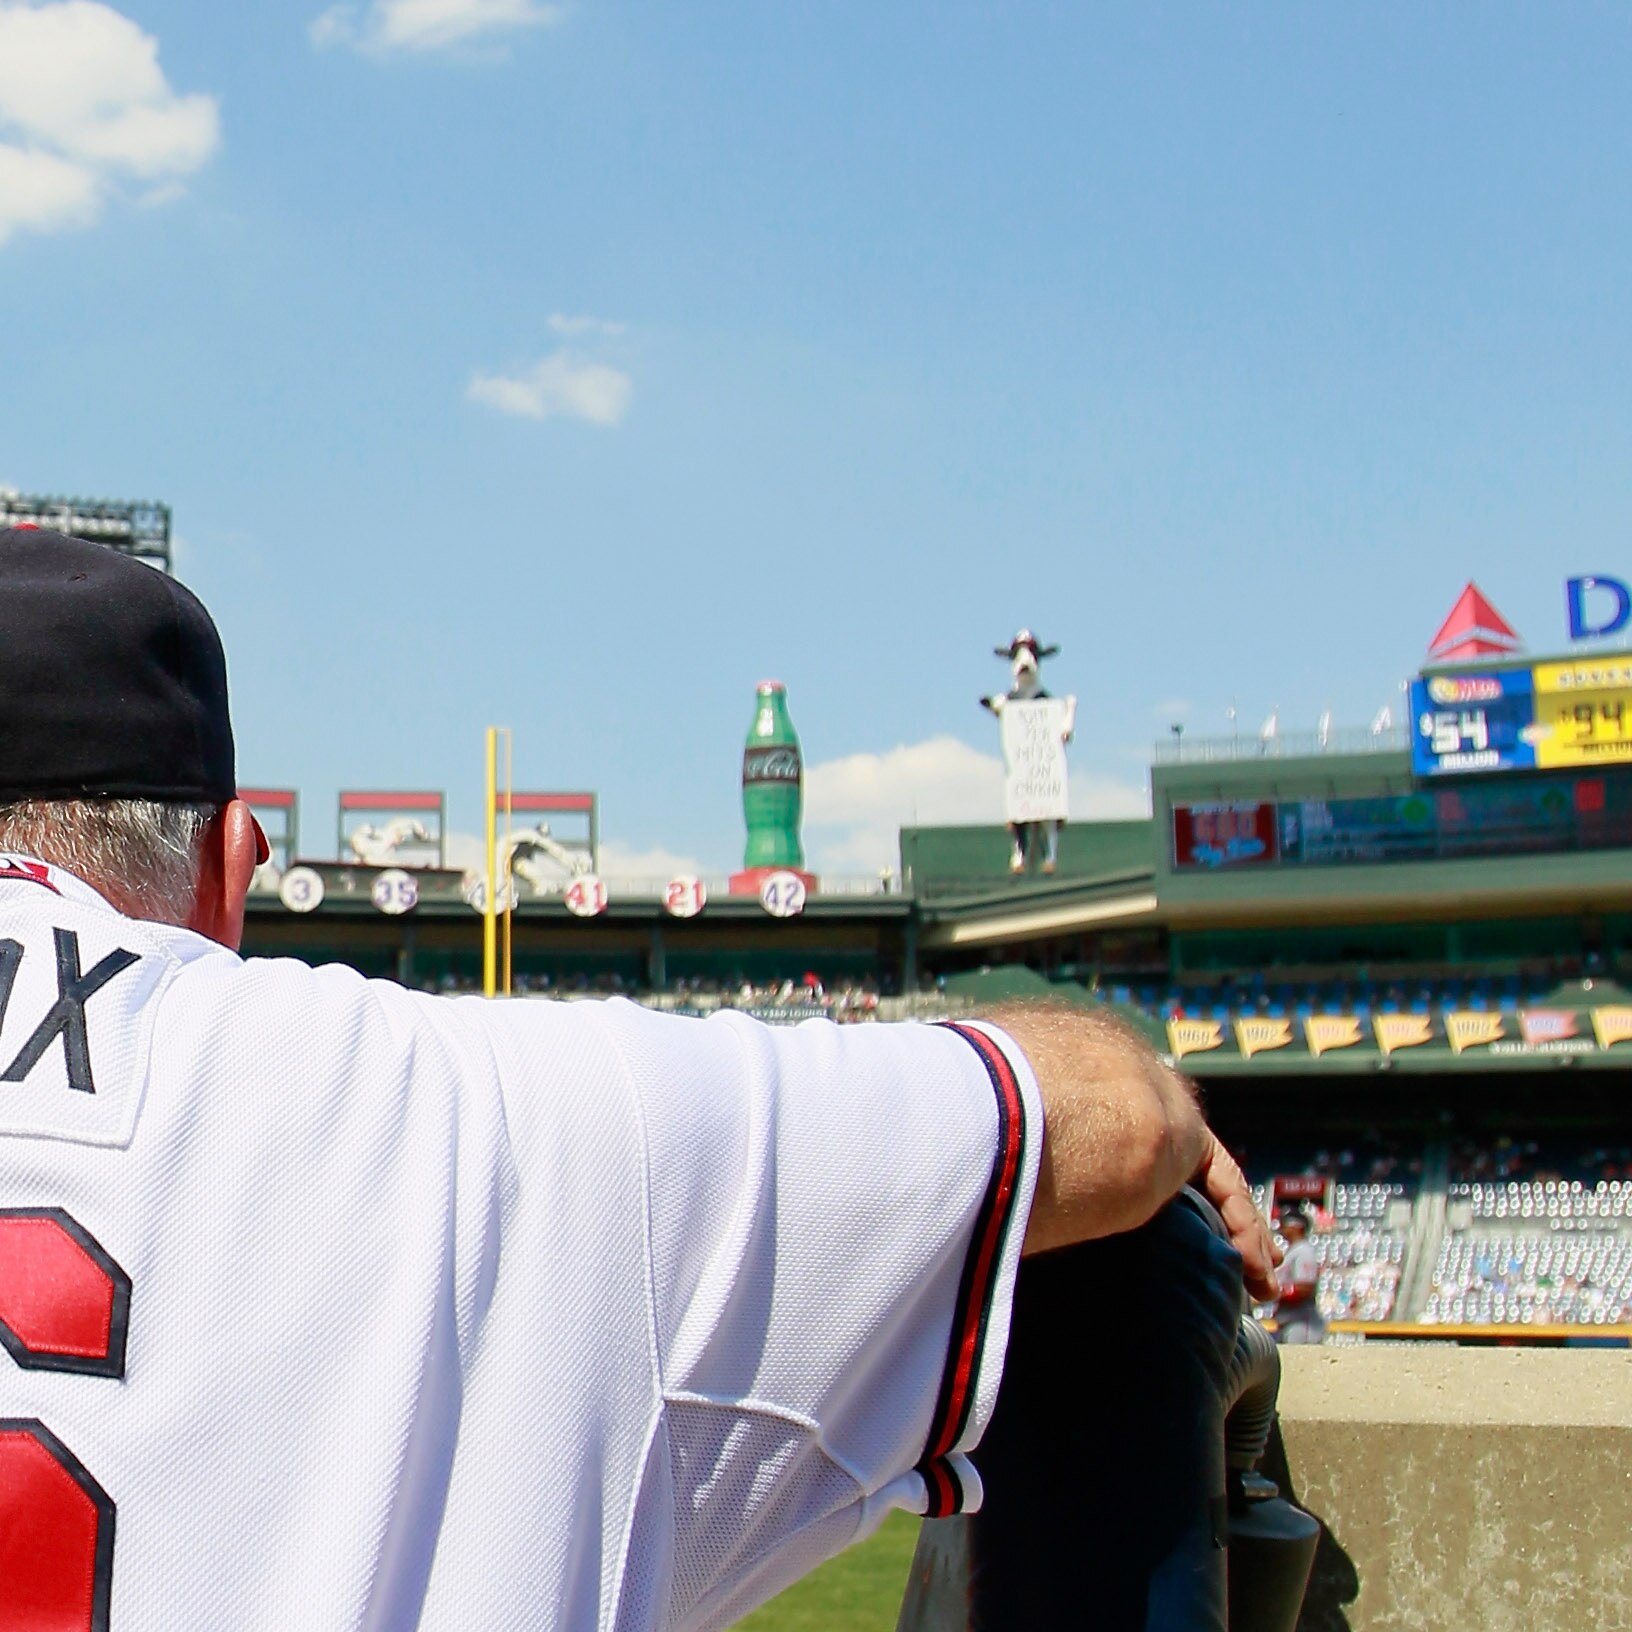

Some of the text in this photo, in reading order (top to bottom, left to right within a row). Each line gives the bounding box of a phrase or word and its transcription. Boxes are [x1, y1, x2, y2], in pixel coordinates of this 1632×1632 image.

[292, 879, 311, 901] 3
[377, 880, 417, 907] 35
[566, 881, 607, 912] 41
[665, 880, 705, 911] 21
[765, 881, 802, 909] 42
